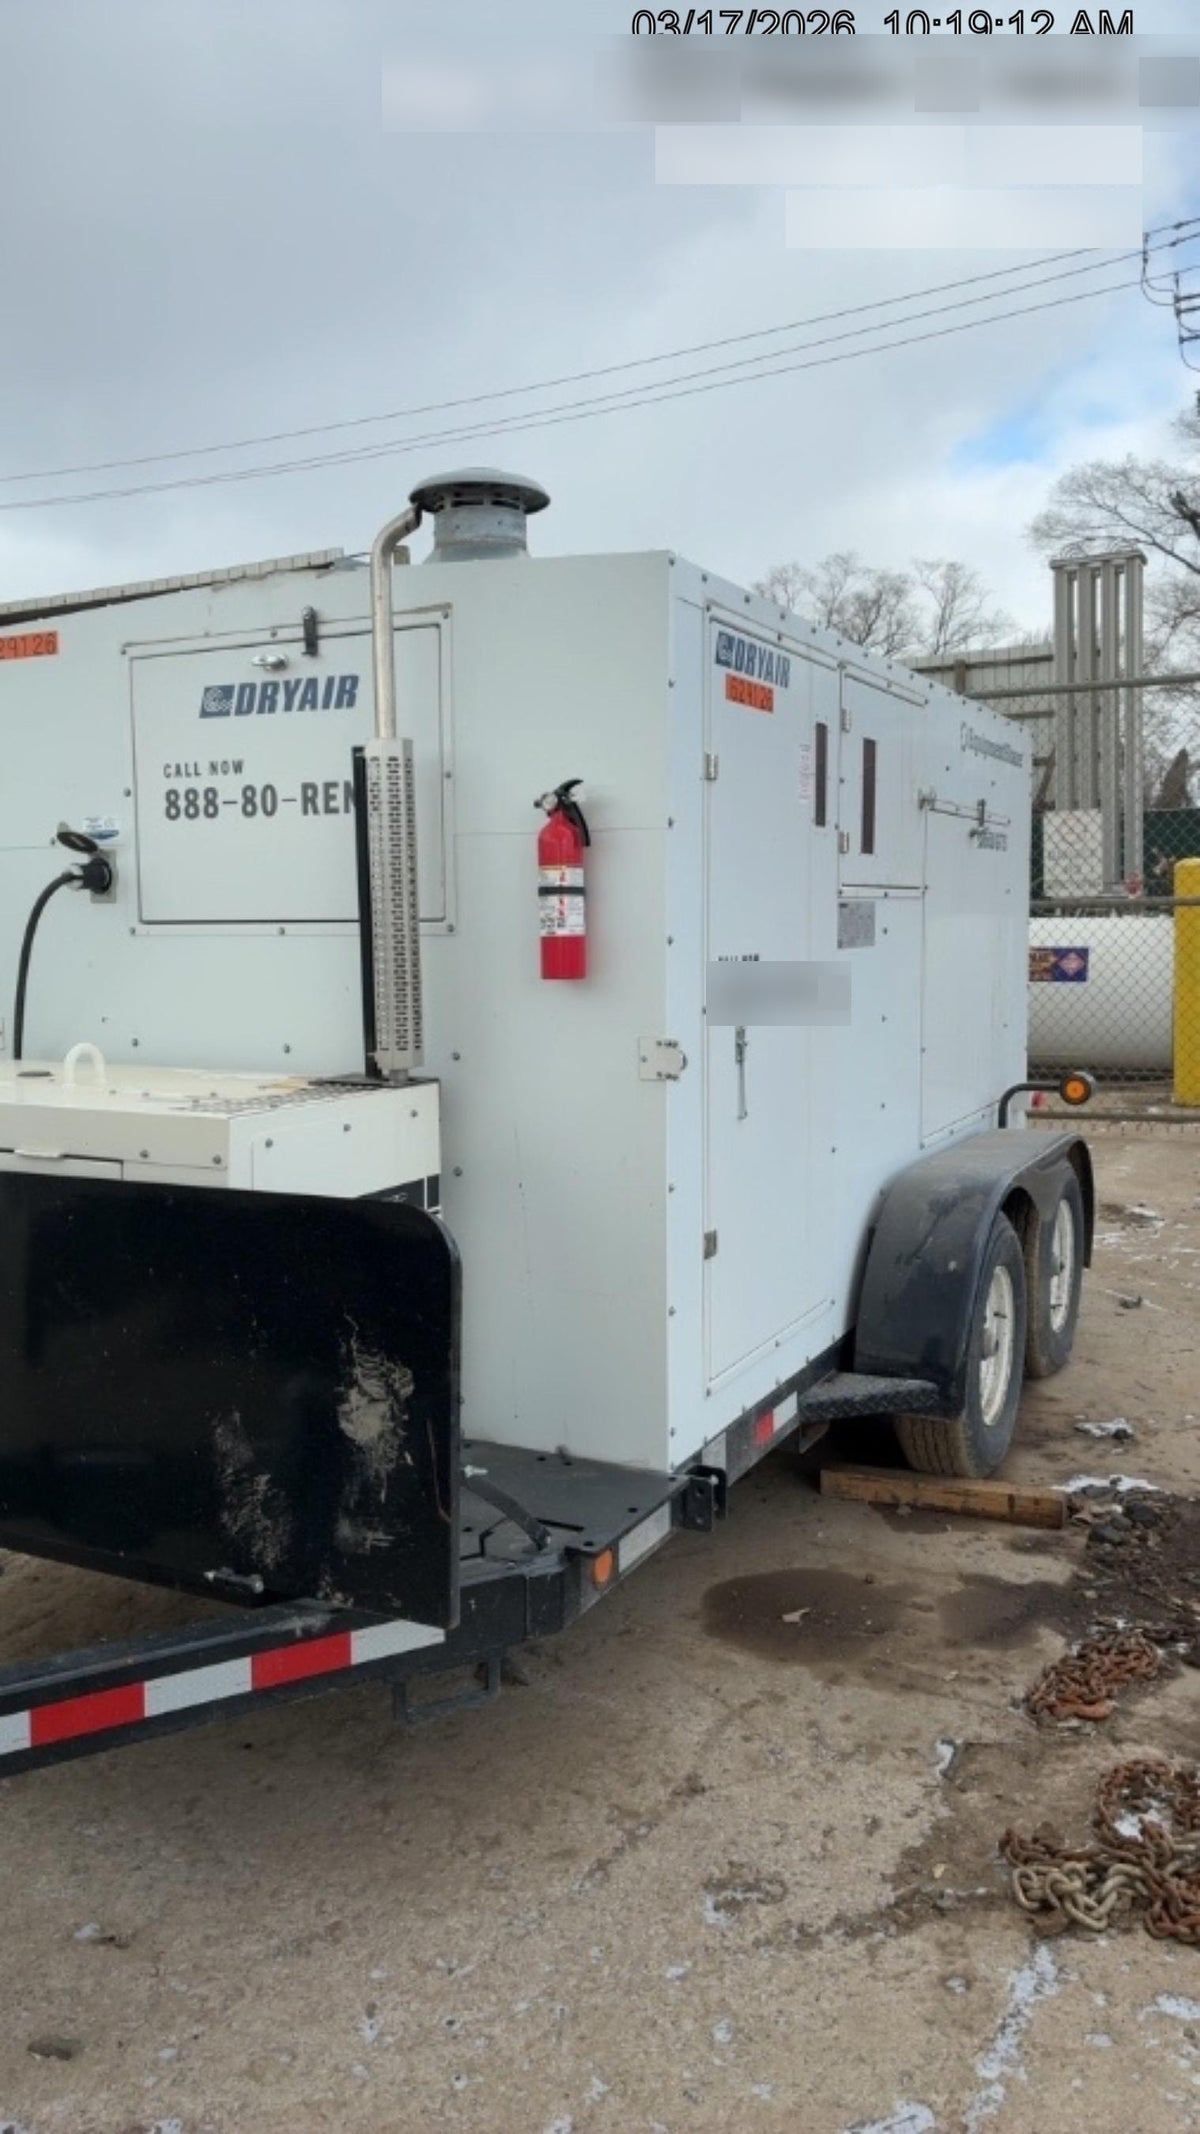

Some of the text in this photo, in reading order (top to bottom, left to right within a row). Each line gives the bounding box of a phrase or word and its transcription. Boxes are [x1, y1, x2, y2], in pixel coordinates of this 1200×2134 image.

[734, 637, 791, 689] DRYAIR
[234, 674, 360, 717] DRYAIR
[163, 760, 245, 779] CALL NOW
